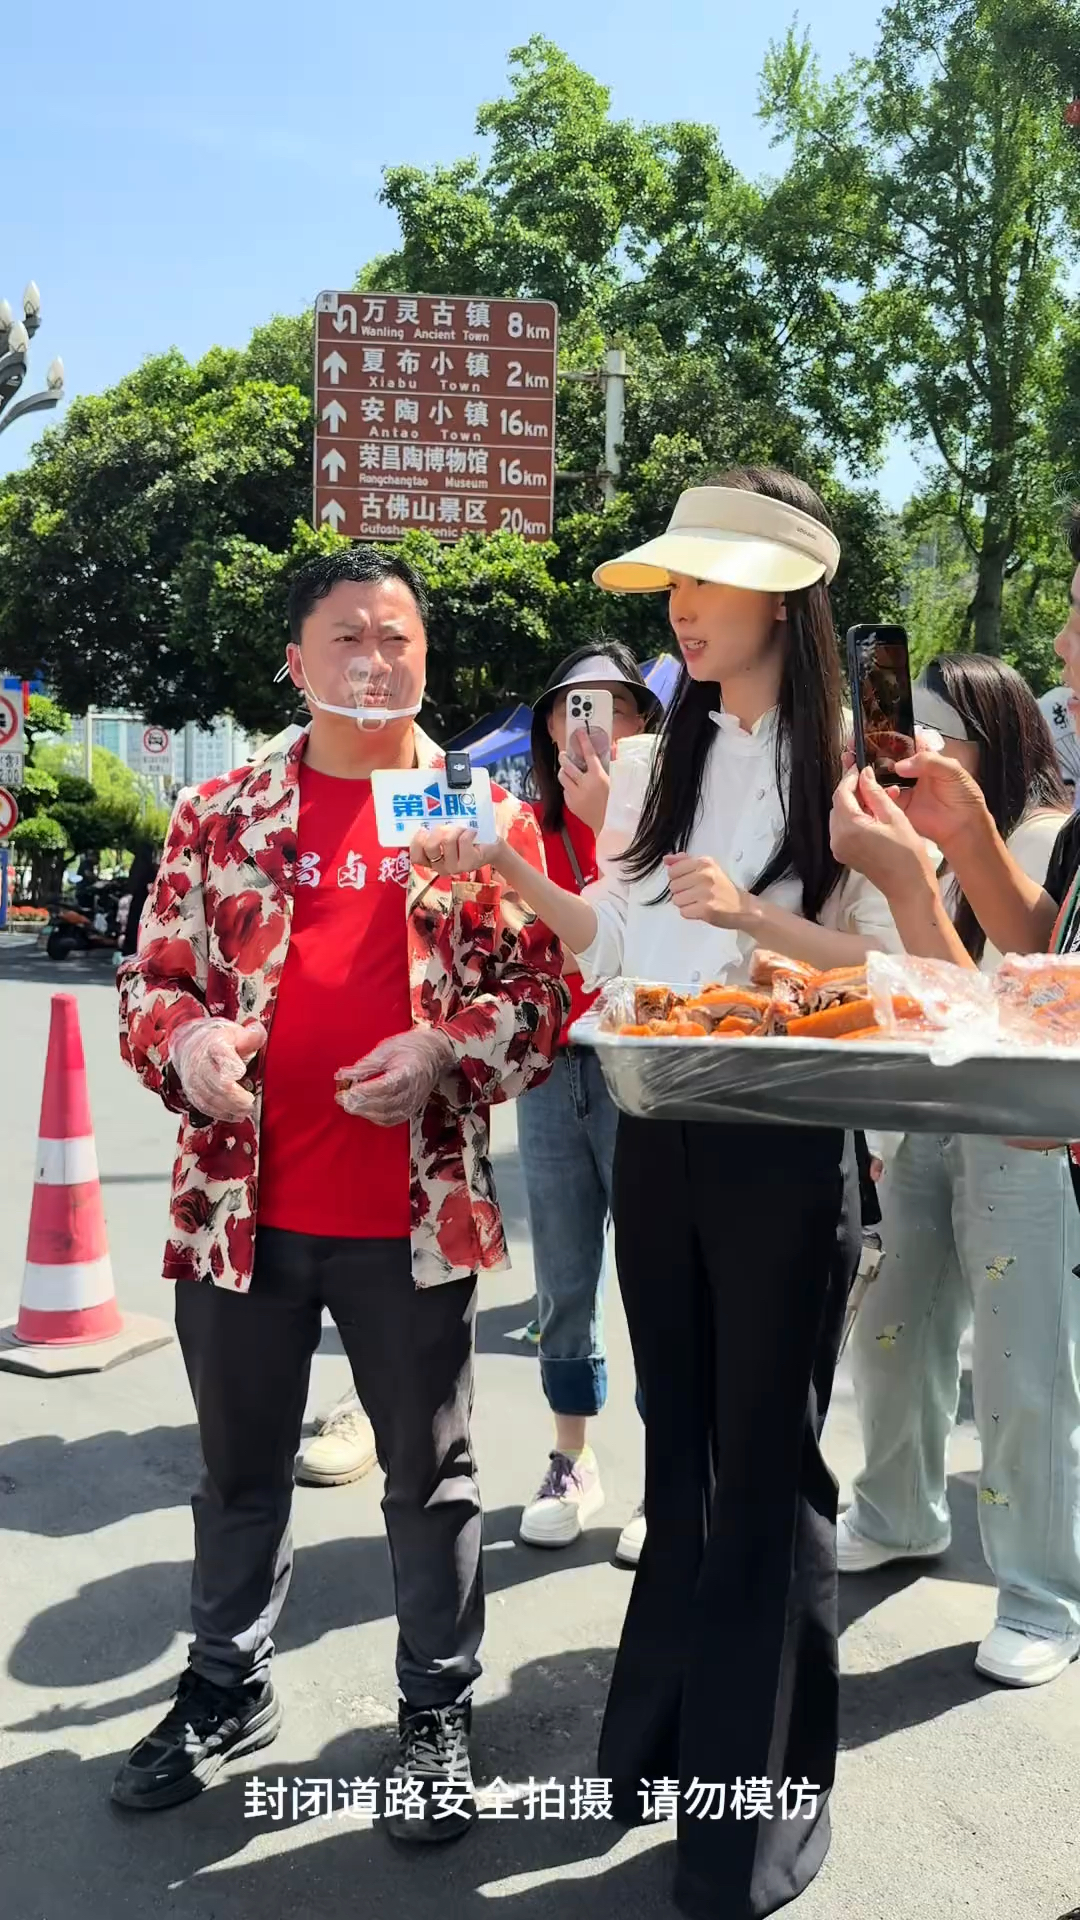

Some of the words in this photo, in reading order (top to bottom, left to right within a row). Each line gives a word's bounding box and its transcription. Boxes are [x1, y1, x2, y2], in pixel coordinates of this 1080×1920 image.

[361, 326, 404, 341] Wanling
[414, 328, 456, 340] Ancient
[463, 330, 490, 342] Town
[362, 298, 491, 328] 万灵古镇
[507, 312, 550, 340] 8km
[361, 347, 490, 378] 夏布小镇
[506, 361, 549, 389] 2km
[368, 376, 417, 389] Xiabu
[440, 380, 480, 392] Town
[360, 396, 489, 427] 安陶小镇
[500, 409, 548, 437] 16km
[369, 426, 419, 439] Antao
[440, 429, 481, 442] Town
[359, 444, 489, 475] 荣昌陶博物馆
[499, 458, 547, 487] 16km
[445, 478, 488, 489] Museum
[360, 492, 488, 524] 古佛山景区
[500, 507, 546, 535] 20km
